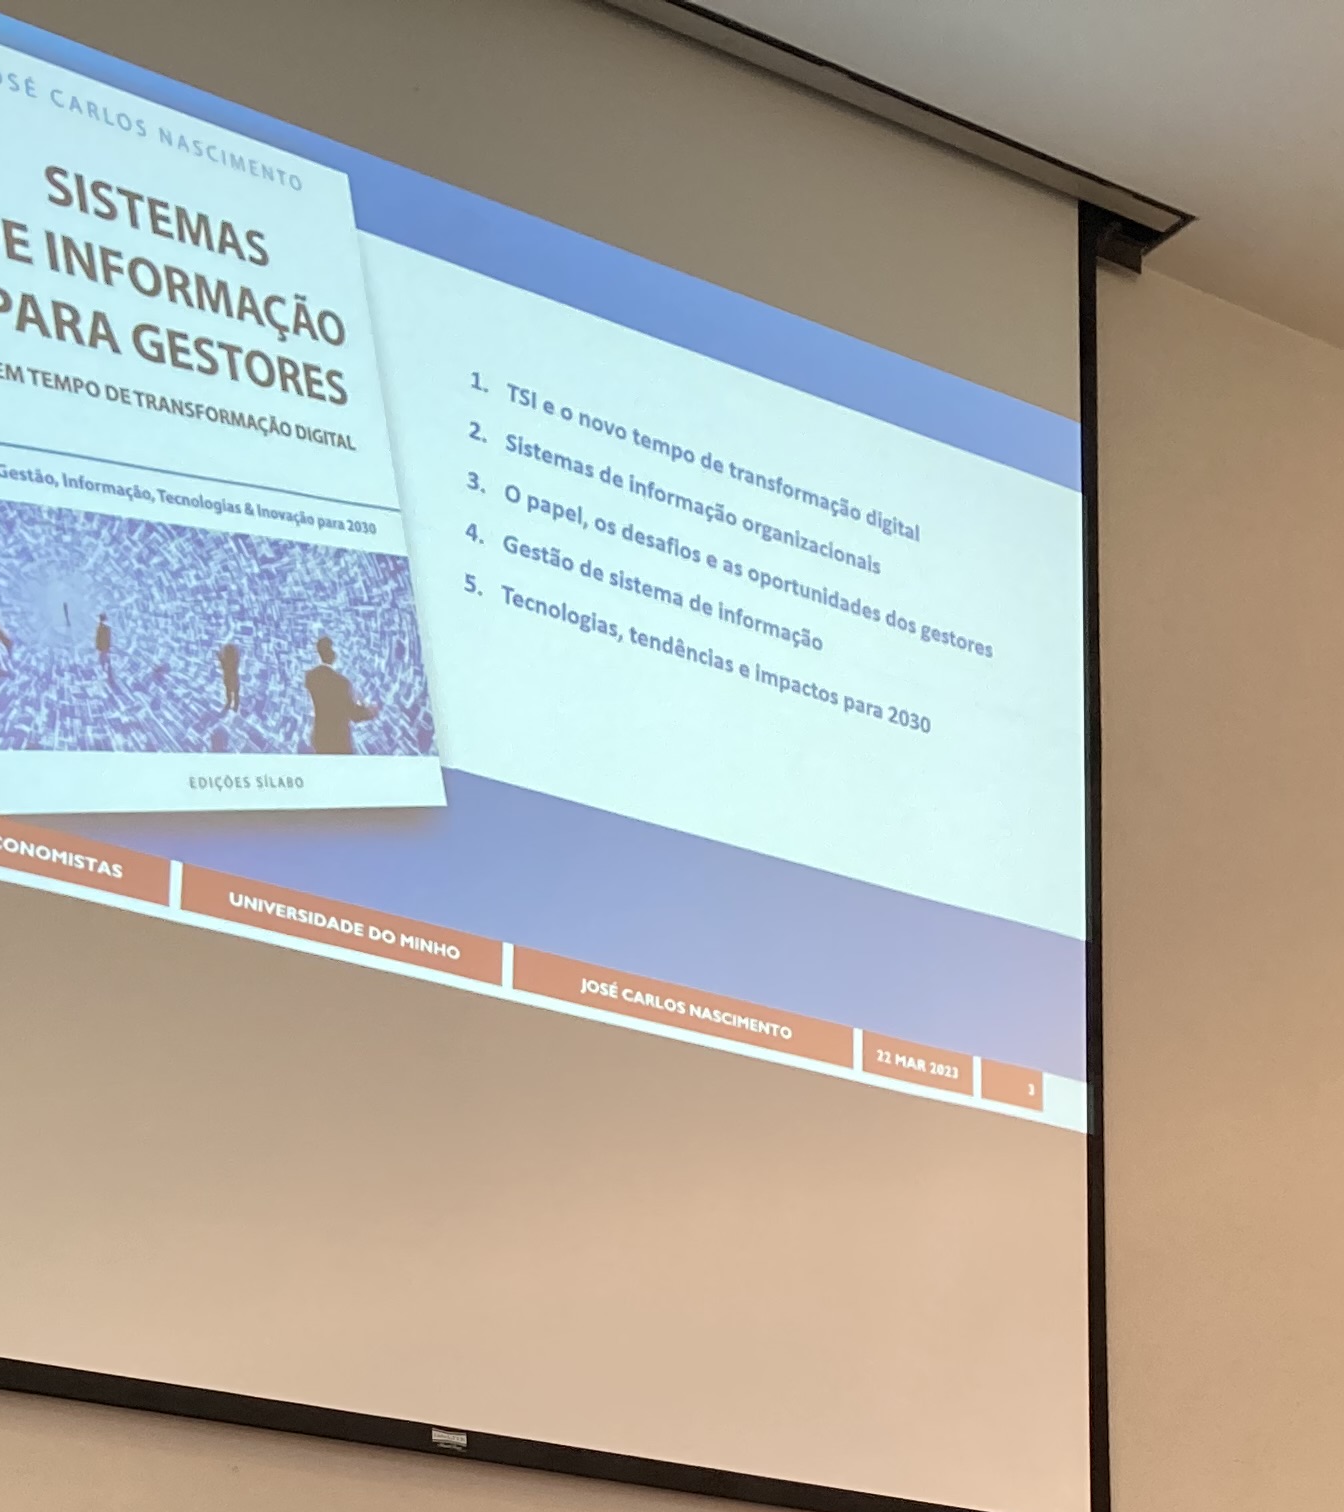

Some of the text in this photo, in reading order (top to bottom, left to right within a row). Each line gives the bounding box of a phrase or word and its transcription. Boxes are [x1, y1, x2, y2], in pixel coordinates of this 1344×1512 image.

[50, 89, 147, 138] CARLOS
[158, 127, 303, 192] NASCIMENTO
[44, 165, 269, 267] SISTEMAS
[44, 229, 346, 348] INFORMAÇÃO
[27, 366, 101, 398] TEMPO
[105, 378, 134, 404] DE
[134, 386, 293, 438] TRANSFORMAÇÃO
[296, 423, 357, 451] DIGITAL
[132, 322, 349, 406] GESTORES
[62, 472, 156, 504] Informação,
[159, 487, 242, 518] Tecnologias
[244, 500, 255, 517] &
[257, 502, 315, 530] Inovação
[317, 516, 343, 534] para
[345, 518, 377, 536] 2030
[469, 421, 881, 576] 2. Sistemas de informação organizacionais
[471, 372, 921, 543] 1. TSI e o novo tempo de transformação digital
[465, 523, 824, 652] 4. Gestão de sistema de informação
[467, 472, 993, 659] 3. O papel, os desafios e as oportunidades dos gestores
[464, 574, 932, 735] 5. Tecnologias, tendências e impactos para 2030
[189, 772, 305, 792] EDIÇÕES SÍLABO
[229, 891, 460, 960] UNIVERSIDADE DO MINHO
[581, 977, 793, 1041] JOSÉ CARLOS NASCIMENTO
[876, 1049, 891, 1064] 22
[895, 1054, 926, 1073] MAR
